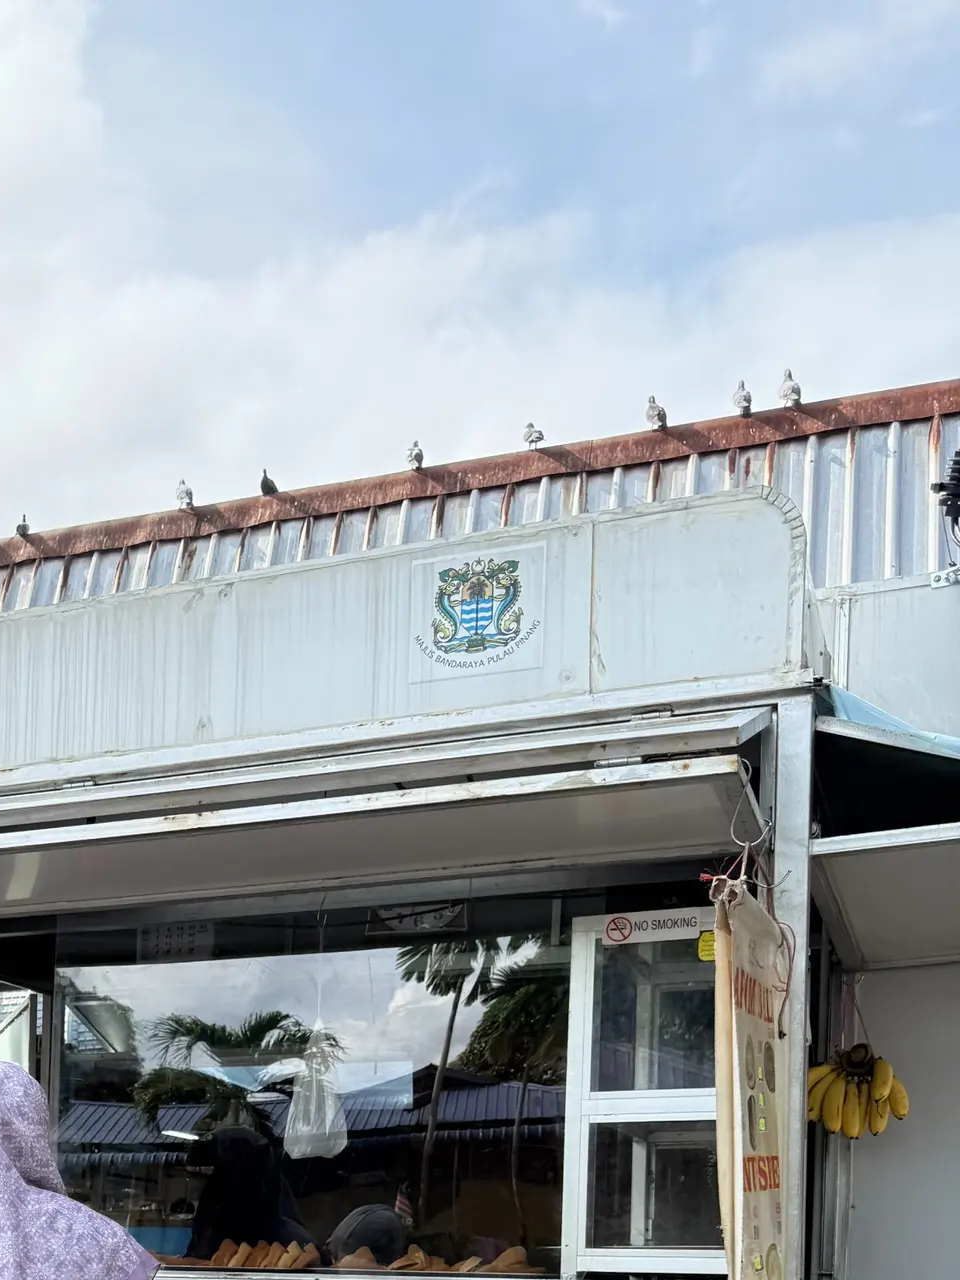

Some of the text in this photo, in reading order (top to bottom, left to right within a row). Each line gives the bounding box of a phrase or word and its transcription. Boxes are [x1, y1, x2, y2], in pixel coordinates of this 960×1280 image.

[414, 620, 541, 669] MAJLIS BANDARAYA PULAU PINANG
[634, 917, 697, 931] NO SMOKING
